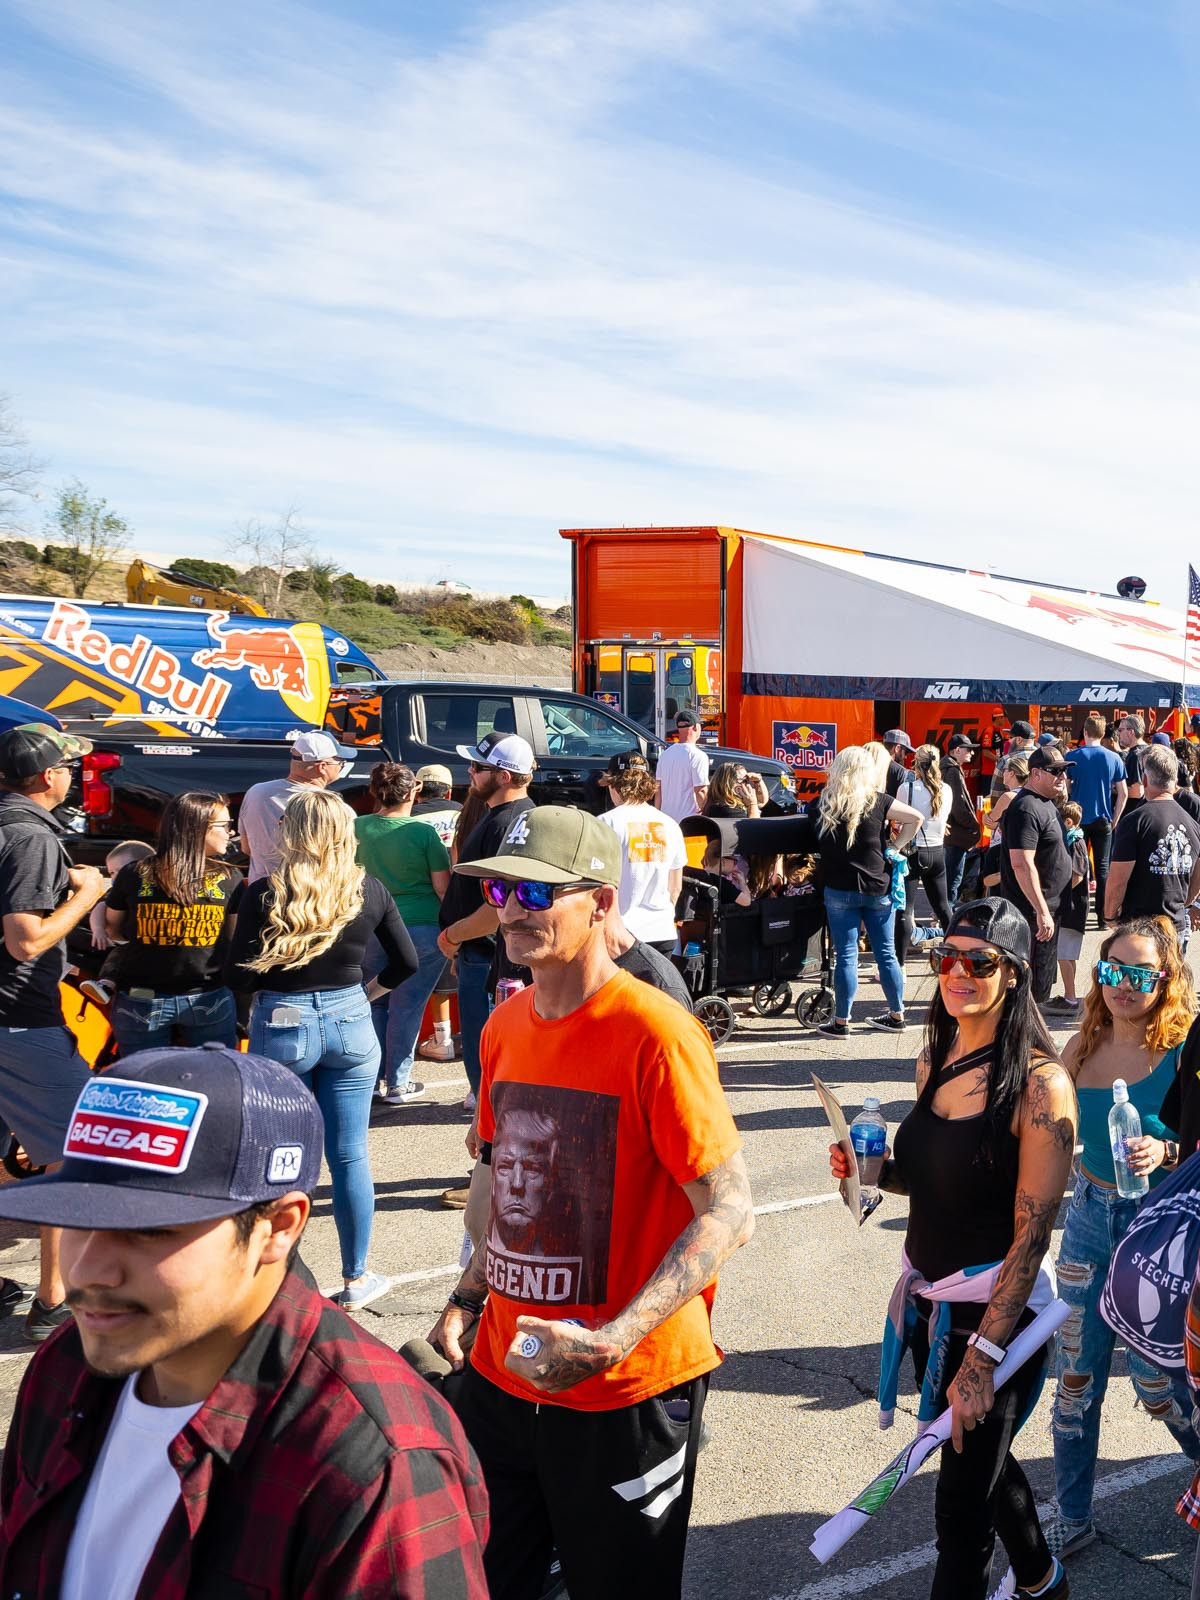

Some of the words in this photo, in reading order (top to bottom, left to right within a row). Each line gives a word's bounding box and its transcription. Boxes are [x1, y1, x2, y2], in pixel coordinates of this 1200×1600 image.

[924, 681, 970, 700] KTM
[1078, 684, 1128, 702] KTM
[776, 748, 804, 766] Red
[805, 749, 833, 767] Bull
[183, 904, 225, 921] STATES
[136, 918, 222, 938] MOTOCROSS
[70, 1121, 179, 1157] GASGAS
[486, 1249, 572, 1300] EGEND
[1131, 1251, 1191, 1295] SKECHER
